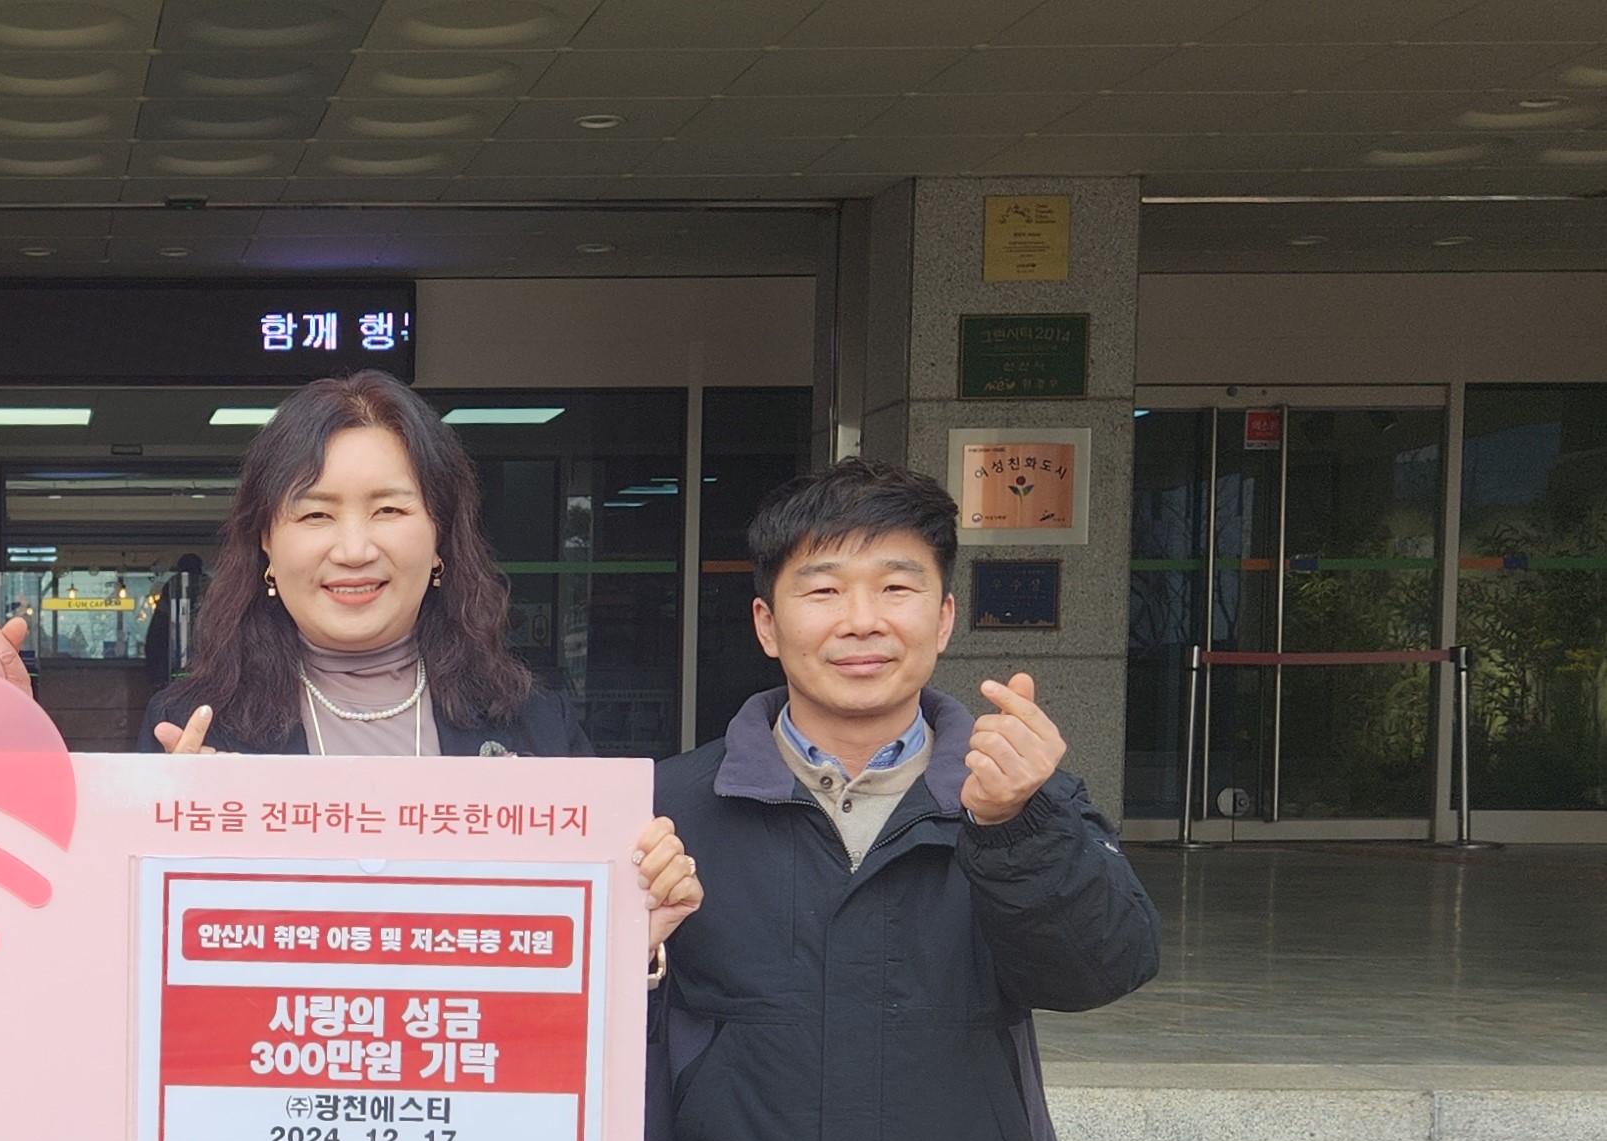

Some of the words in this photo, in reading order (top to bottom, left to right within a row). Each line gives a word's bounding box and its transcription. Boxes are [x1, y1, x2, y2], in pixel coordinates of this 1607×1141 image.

[260, 312, 338, 350] 함께
[358, 312, 409, 350] 행
[975, 456, 1067, 480] 여성친화도시
[155, 800, 248, 832] 나눔을
[260, 802, 387, 834] 전파하는
[398, 803, 588, 837] 따뜻한에너지
[198, 924, 264, 950] 안산시
[273, 924, 319, 950] 취약
[327, 926, 371, 951] 아동
[380, 927, 402, 952] 및
[410, 928, 502, 954] 저소득층
[509, 929, 554, 954] 지원
[268, 995, 385, 1038] 사랑의
[401, 997, 482, 1040] 성금
[250, 1040, 402, 1082] 300만원
[419, 1041, 500, 1084] 기탁
